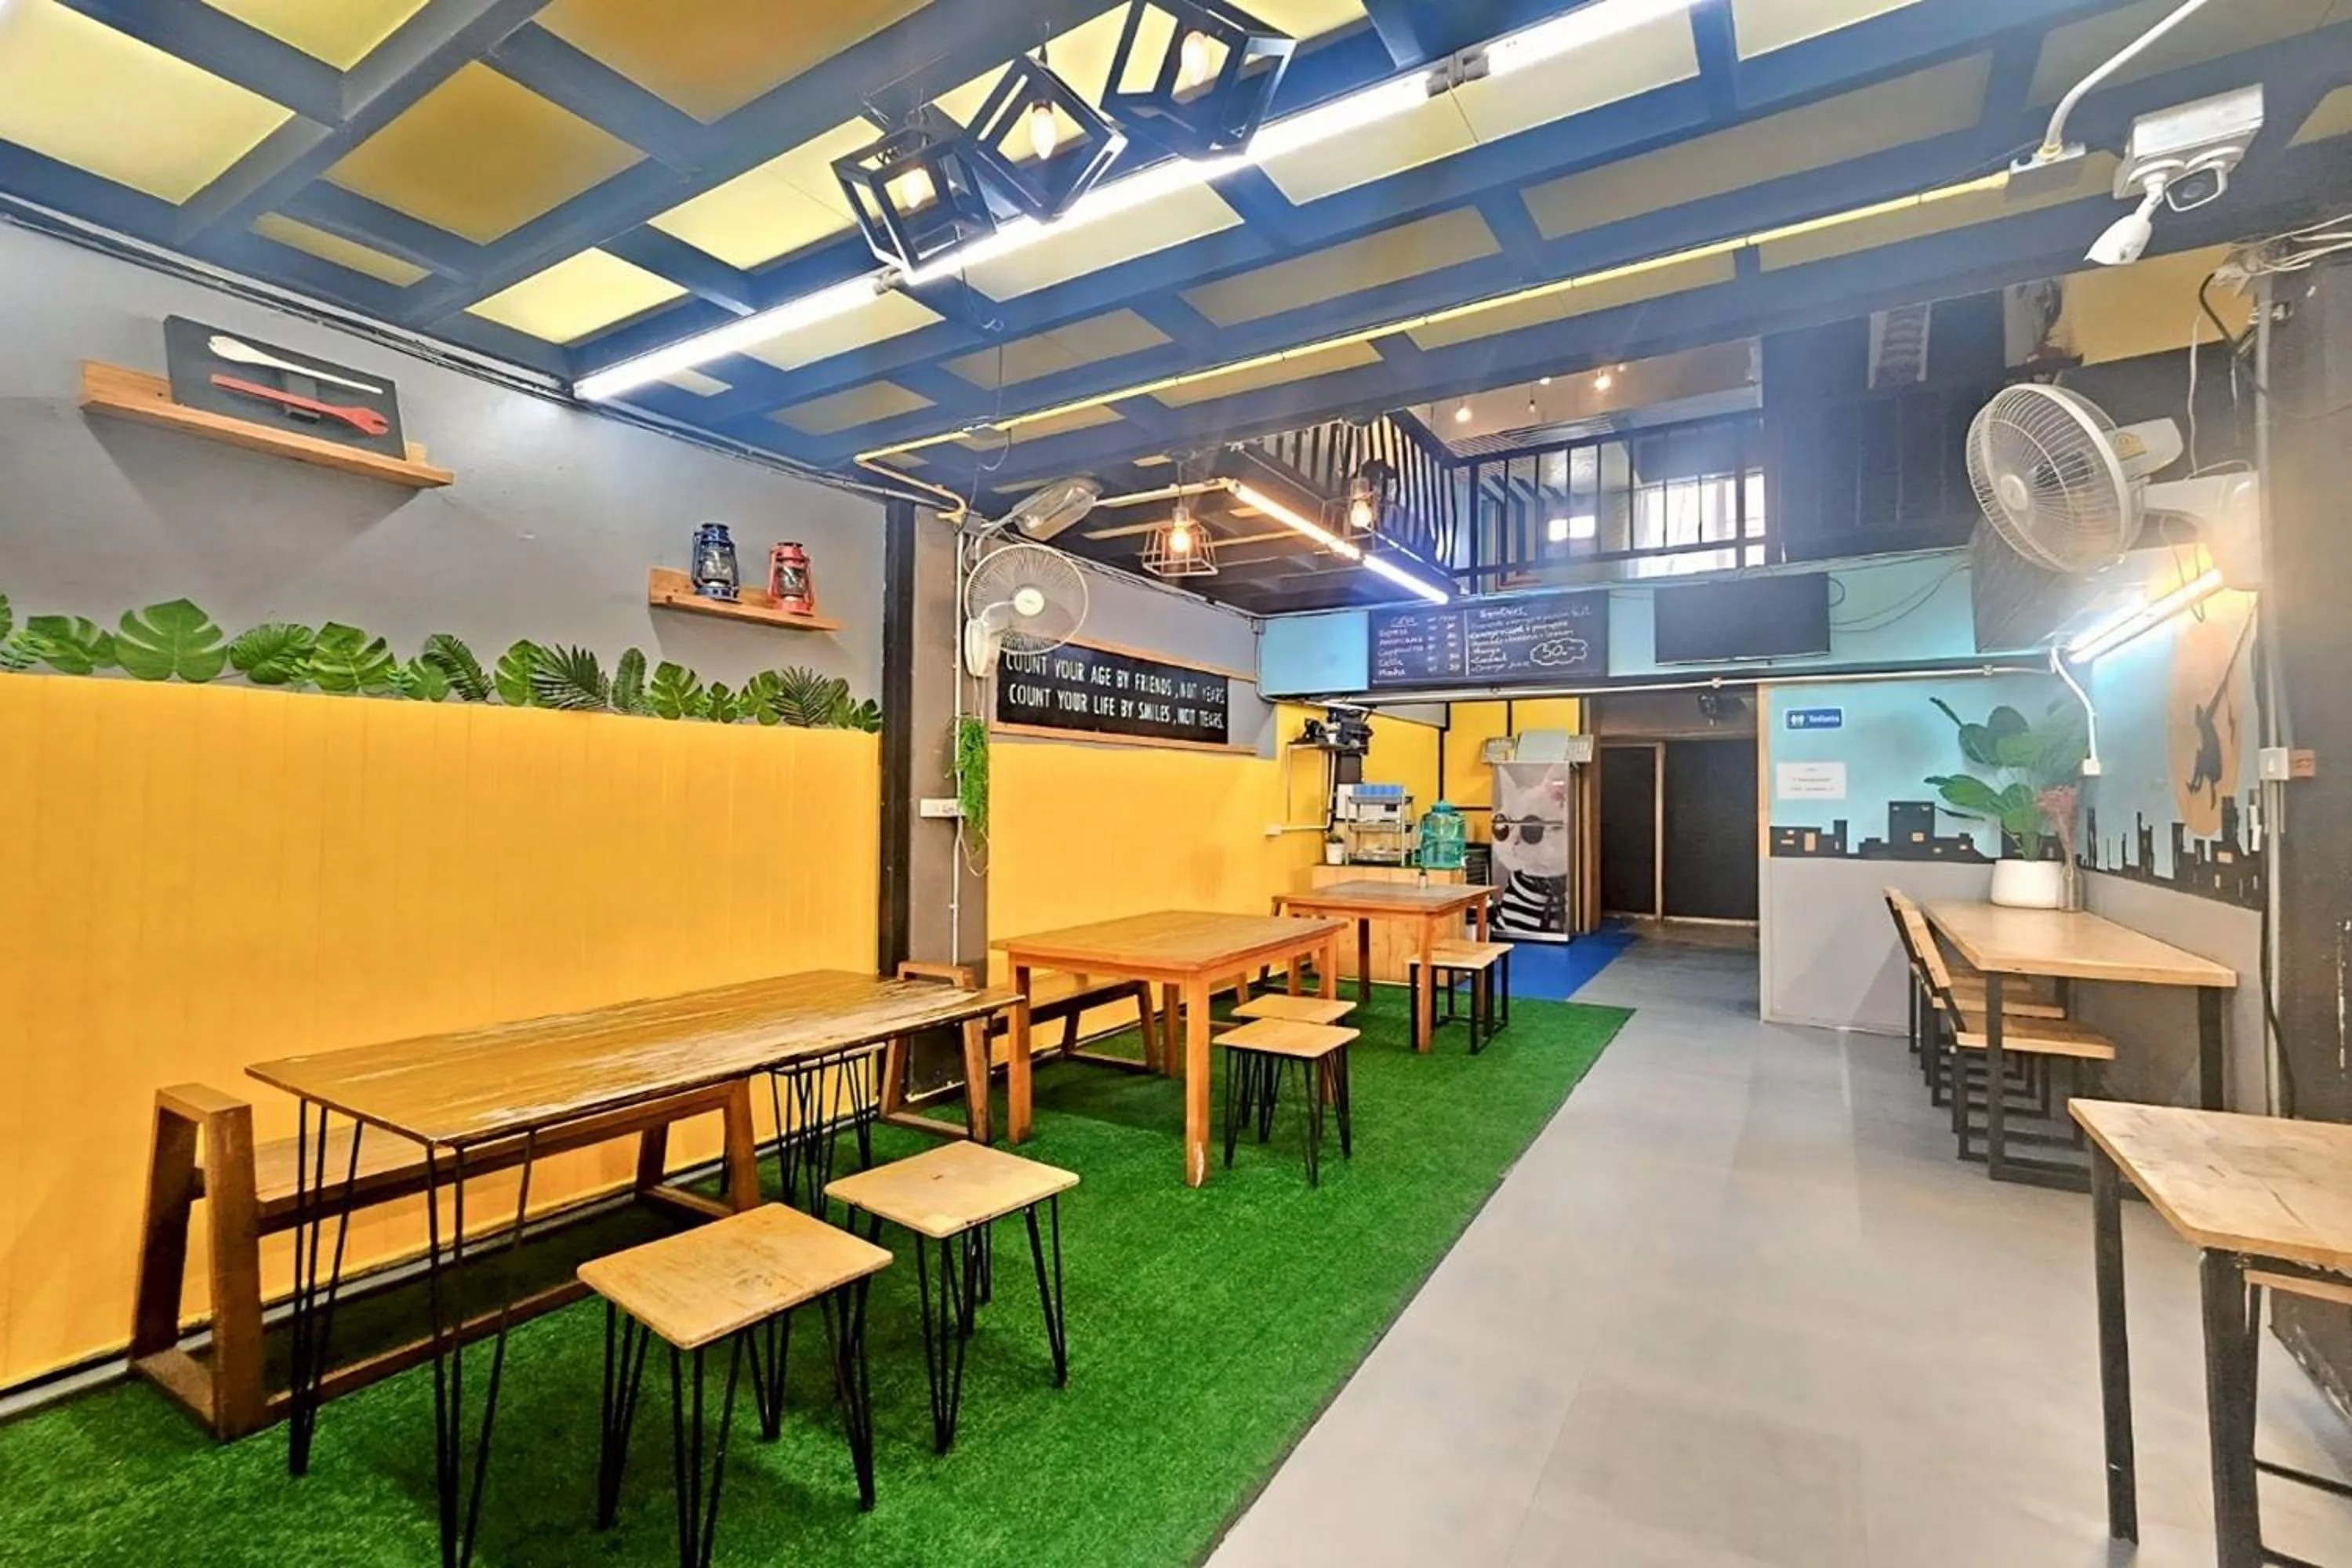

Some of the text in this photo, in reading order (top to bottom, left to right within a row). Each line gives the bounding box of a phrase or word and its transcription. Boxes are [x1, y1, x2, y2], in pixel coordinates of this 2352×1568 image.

[1006, 654, 1047, 675] COUNT
[1054, 659, 1085, 682] YOUR
[1091, 665, 1112, 686] AGE
[1116, 670, 1130, 689] BY
[1009, 683, 1051, 708] COUNT
[1058, 690, 1087, 713] YOUR
[1094, 695, 1115, 717] LIFE
[1120, 699, 1134, 717] BY
[1138, 702, 1171, 723] SMILES
